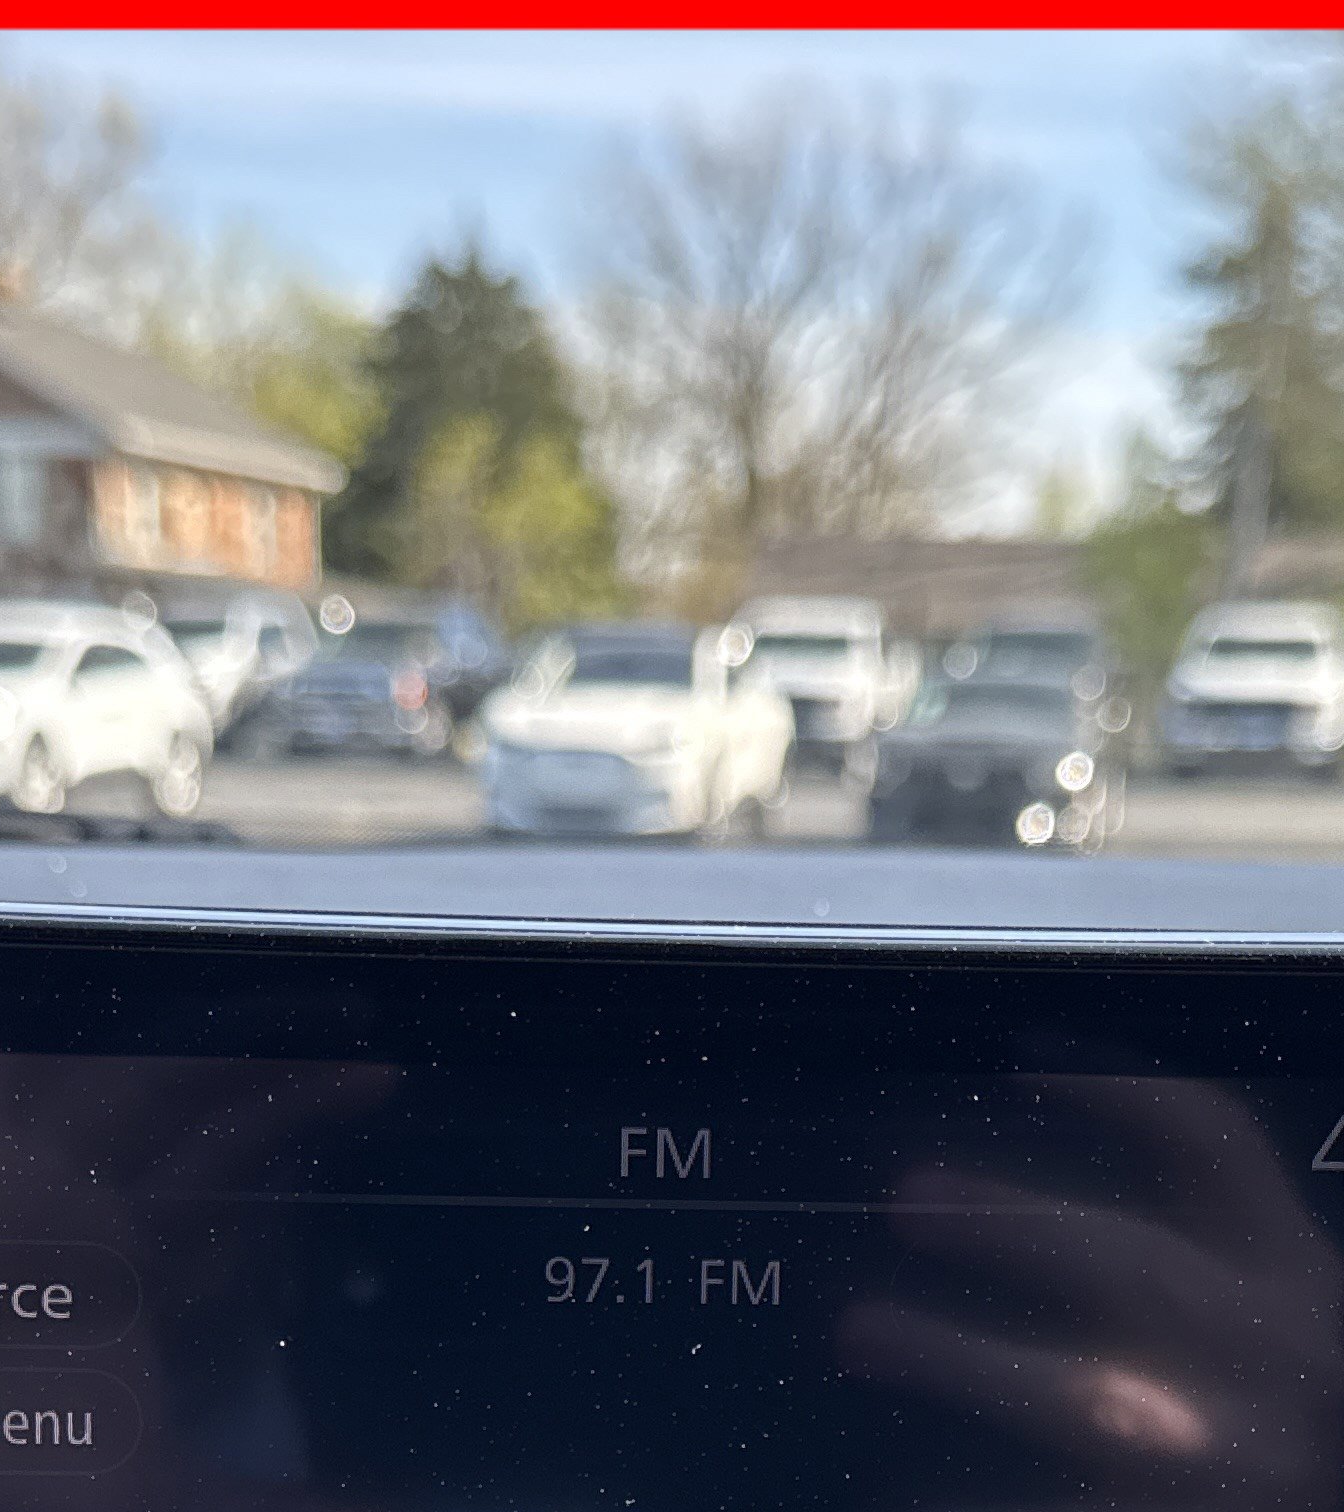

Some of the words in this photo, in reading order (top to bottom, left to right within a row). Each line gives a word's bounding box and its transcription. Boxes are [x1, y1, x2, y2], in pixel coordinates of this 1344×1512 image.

[618, 1126, 713, 1180] FM
[544, 1256, 660, 1306] 97.1
[698, 1257, 783, 1307] FM
